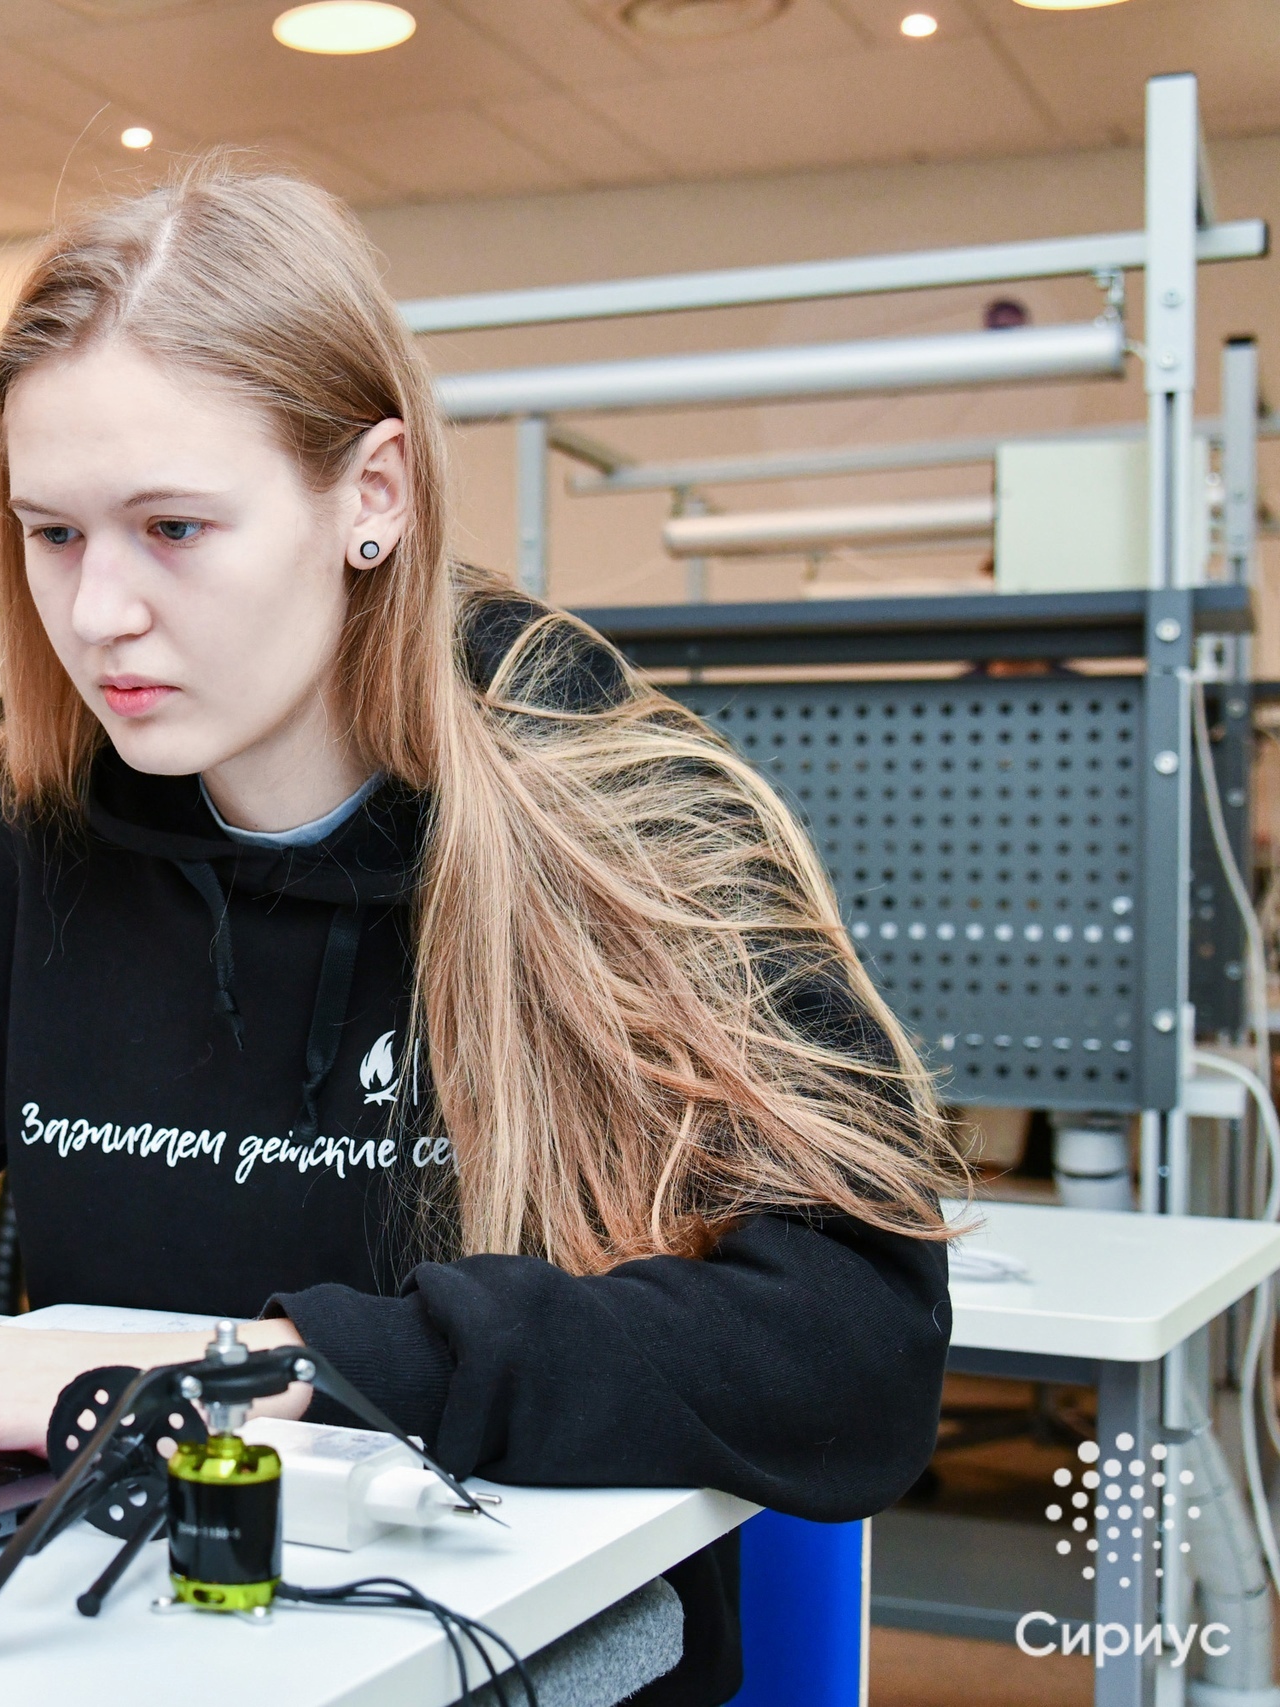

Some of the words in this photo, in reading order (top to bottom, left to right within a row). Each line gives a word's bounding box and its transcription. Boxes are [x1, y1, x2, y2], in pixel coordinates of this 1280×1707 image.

[20, 1101, 228, 1168] Зажигаем
[234, 1129, 398, 1185] детские
[412, 1136, 461, 1178] се
